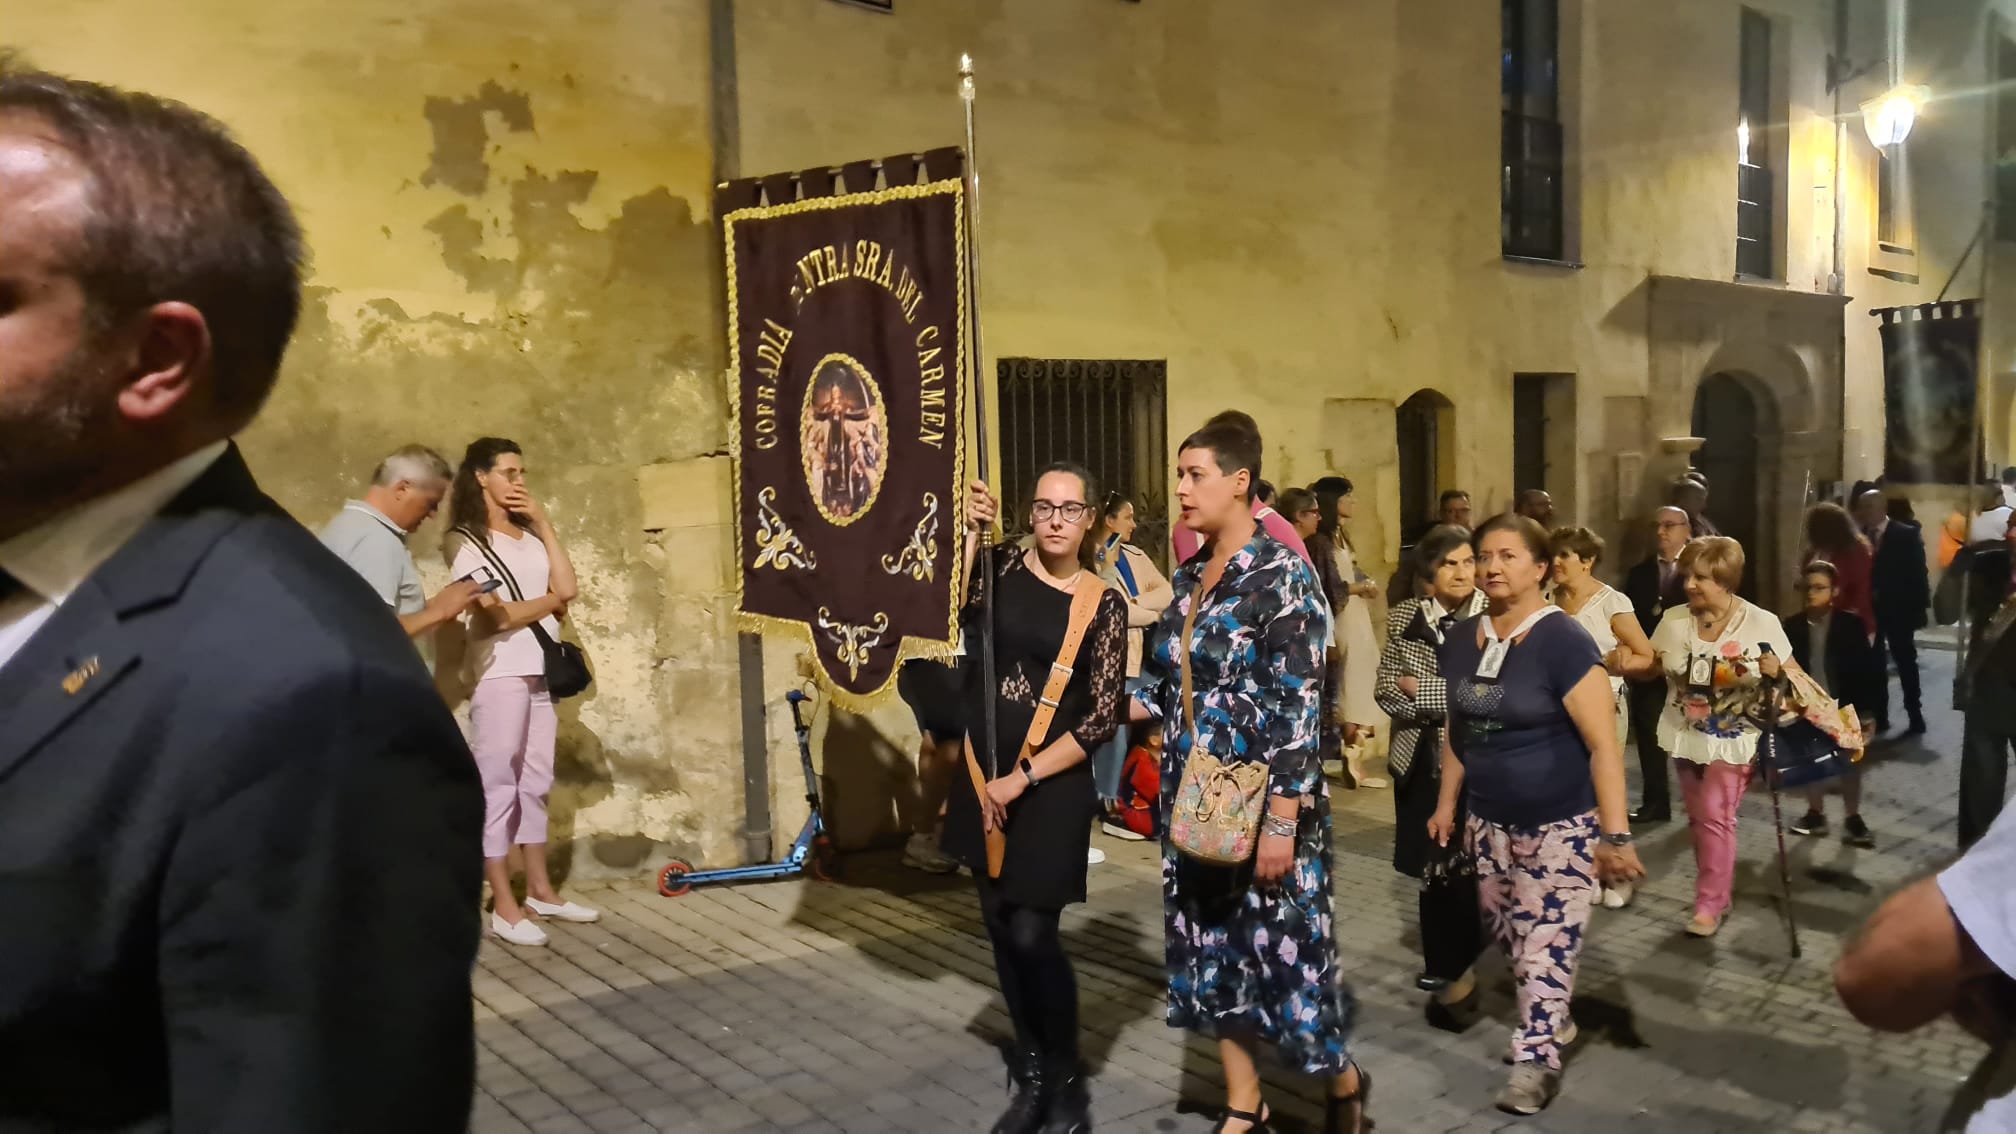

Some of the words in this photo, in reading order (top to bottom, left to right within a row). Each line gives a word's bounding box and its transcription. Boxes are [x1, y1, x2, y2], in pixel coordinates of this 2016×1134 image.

[755, 318, 793, 450] COFRADIA
[895, 265, 924, 325] DEL
[915, 325, 946, 450] CARMEN
